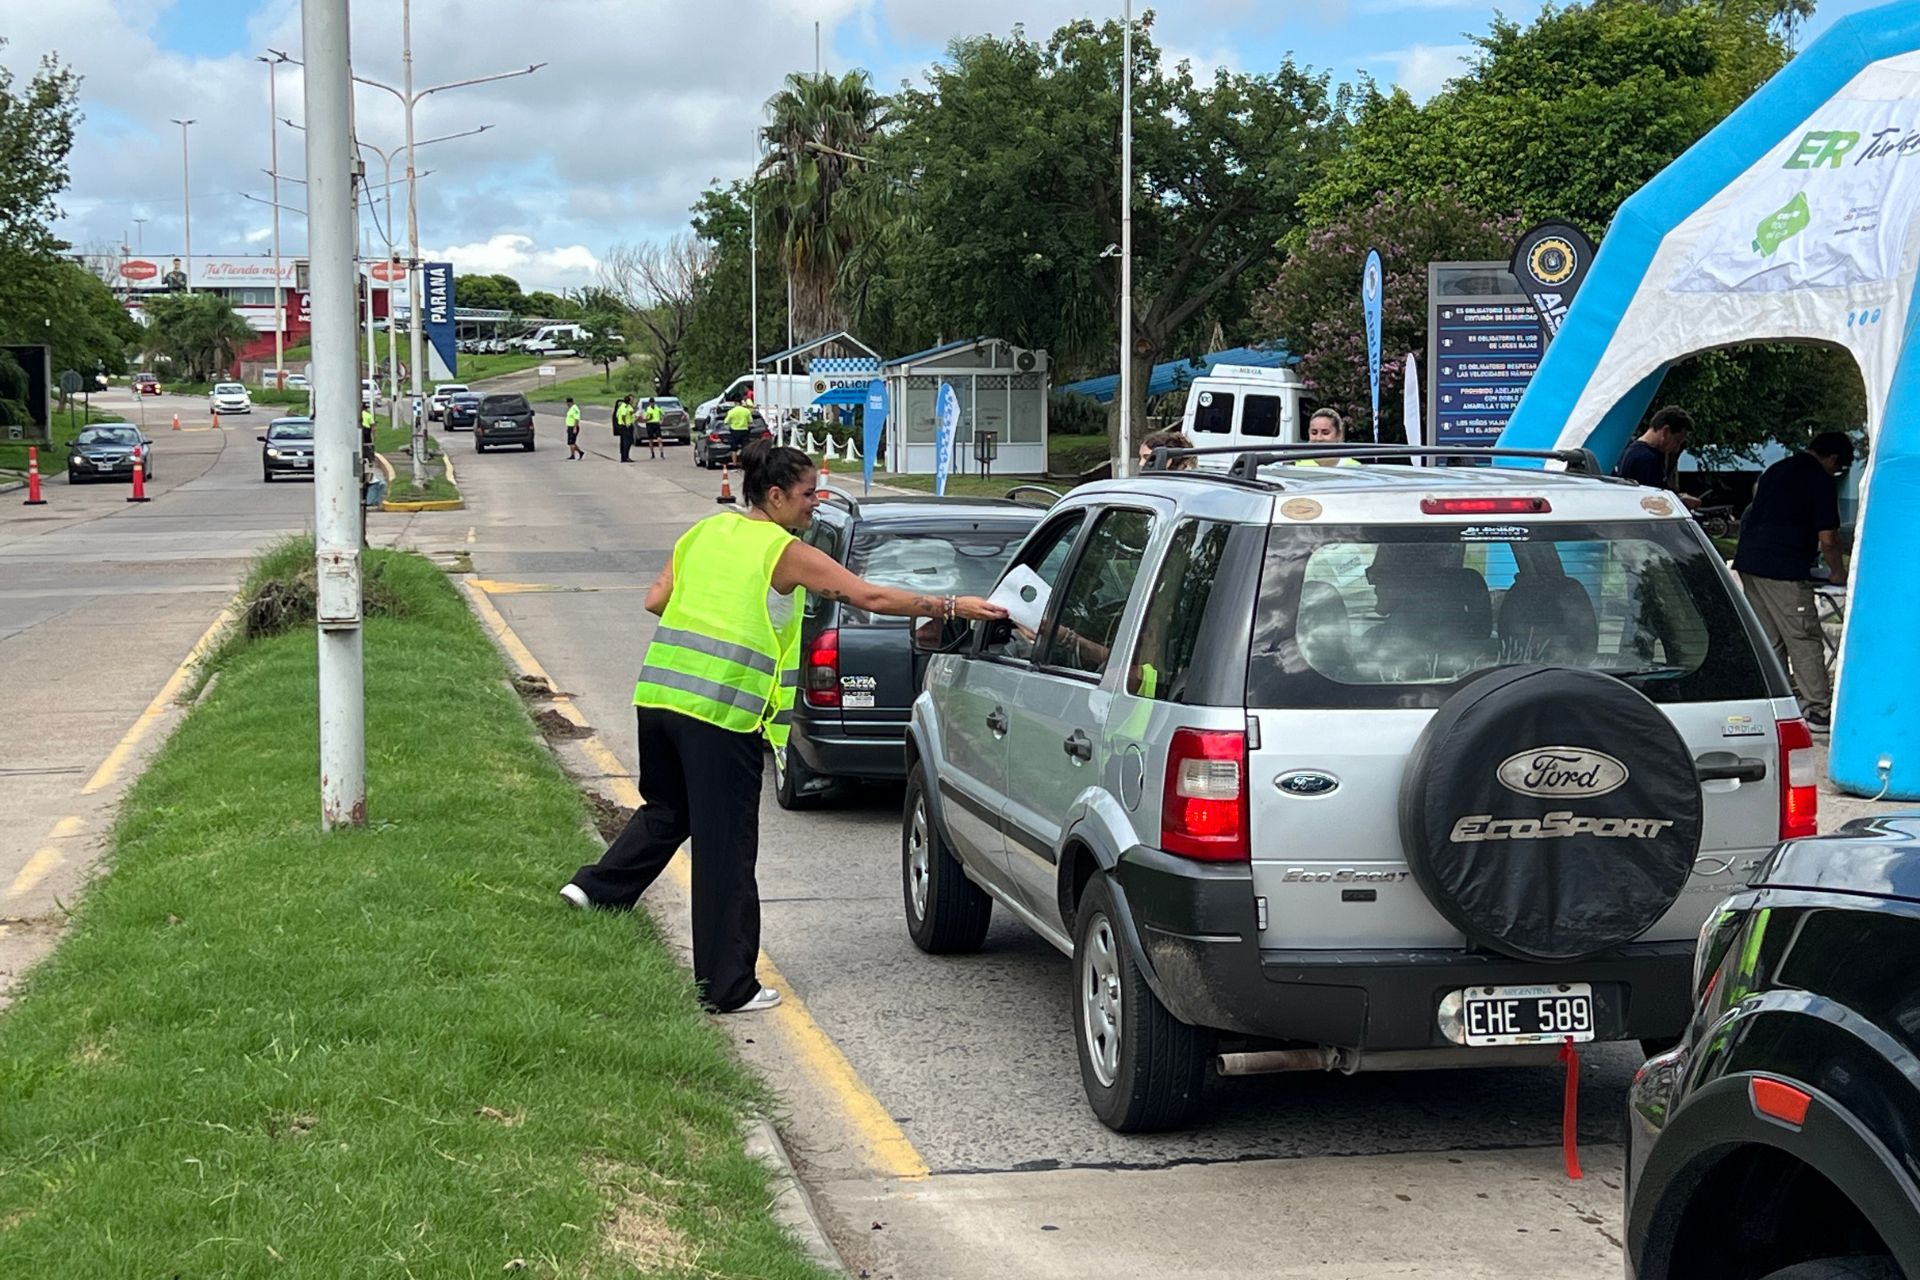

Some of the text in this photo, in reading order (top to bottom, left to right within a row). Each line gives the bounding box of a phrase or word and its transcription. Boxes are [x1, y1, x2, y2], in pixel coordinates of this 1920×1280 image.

[1782, 130, 1860, 169] ER
[221, 263, 259, 274] Tienda
[425, 268, 447, 323] PARANÁ
[1524, 755, 1601, 788] Ford
[1502, 987, 1552, 996] ARGENTINA
[1470, 999, 1589, 1034] EHE 589
